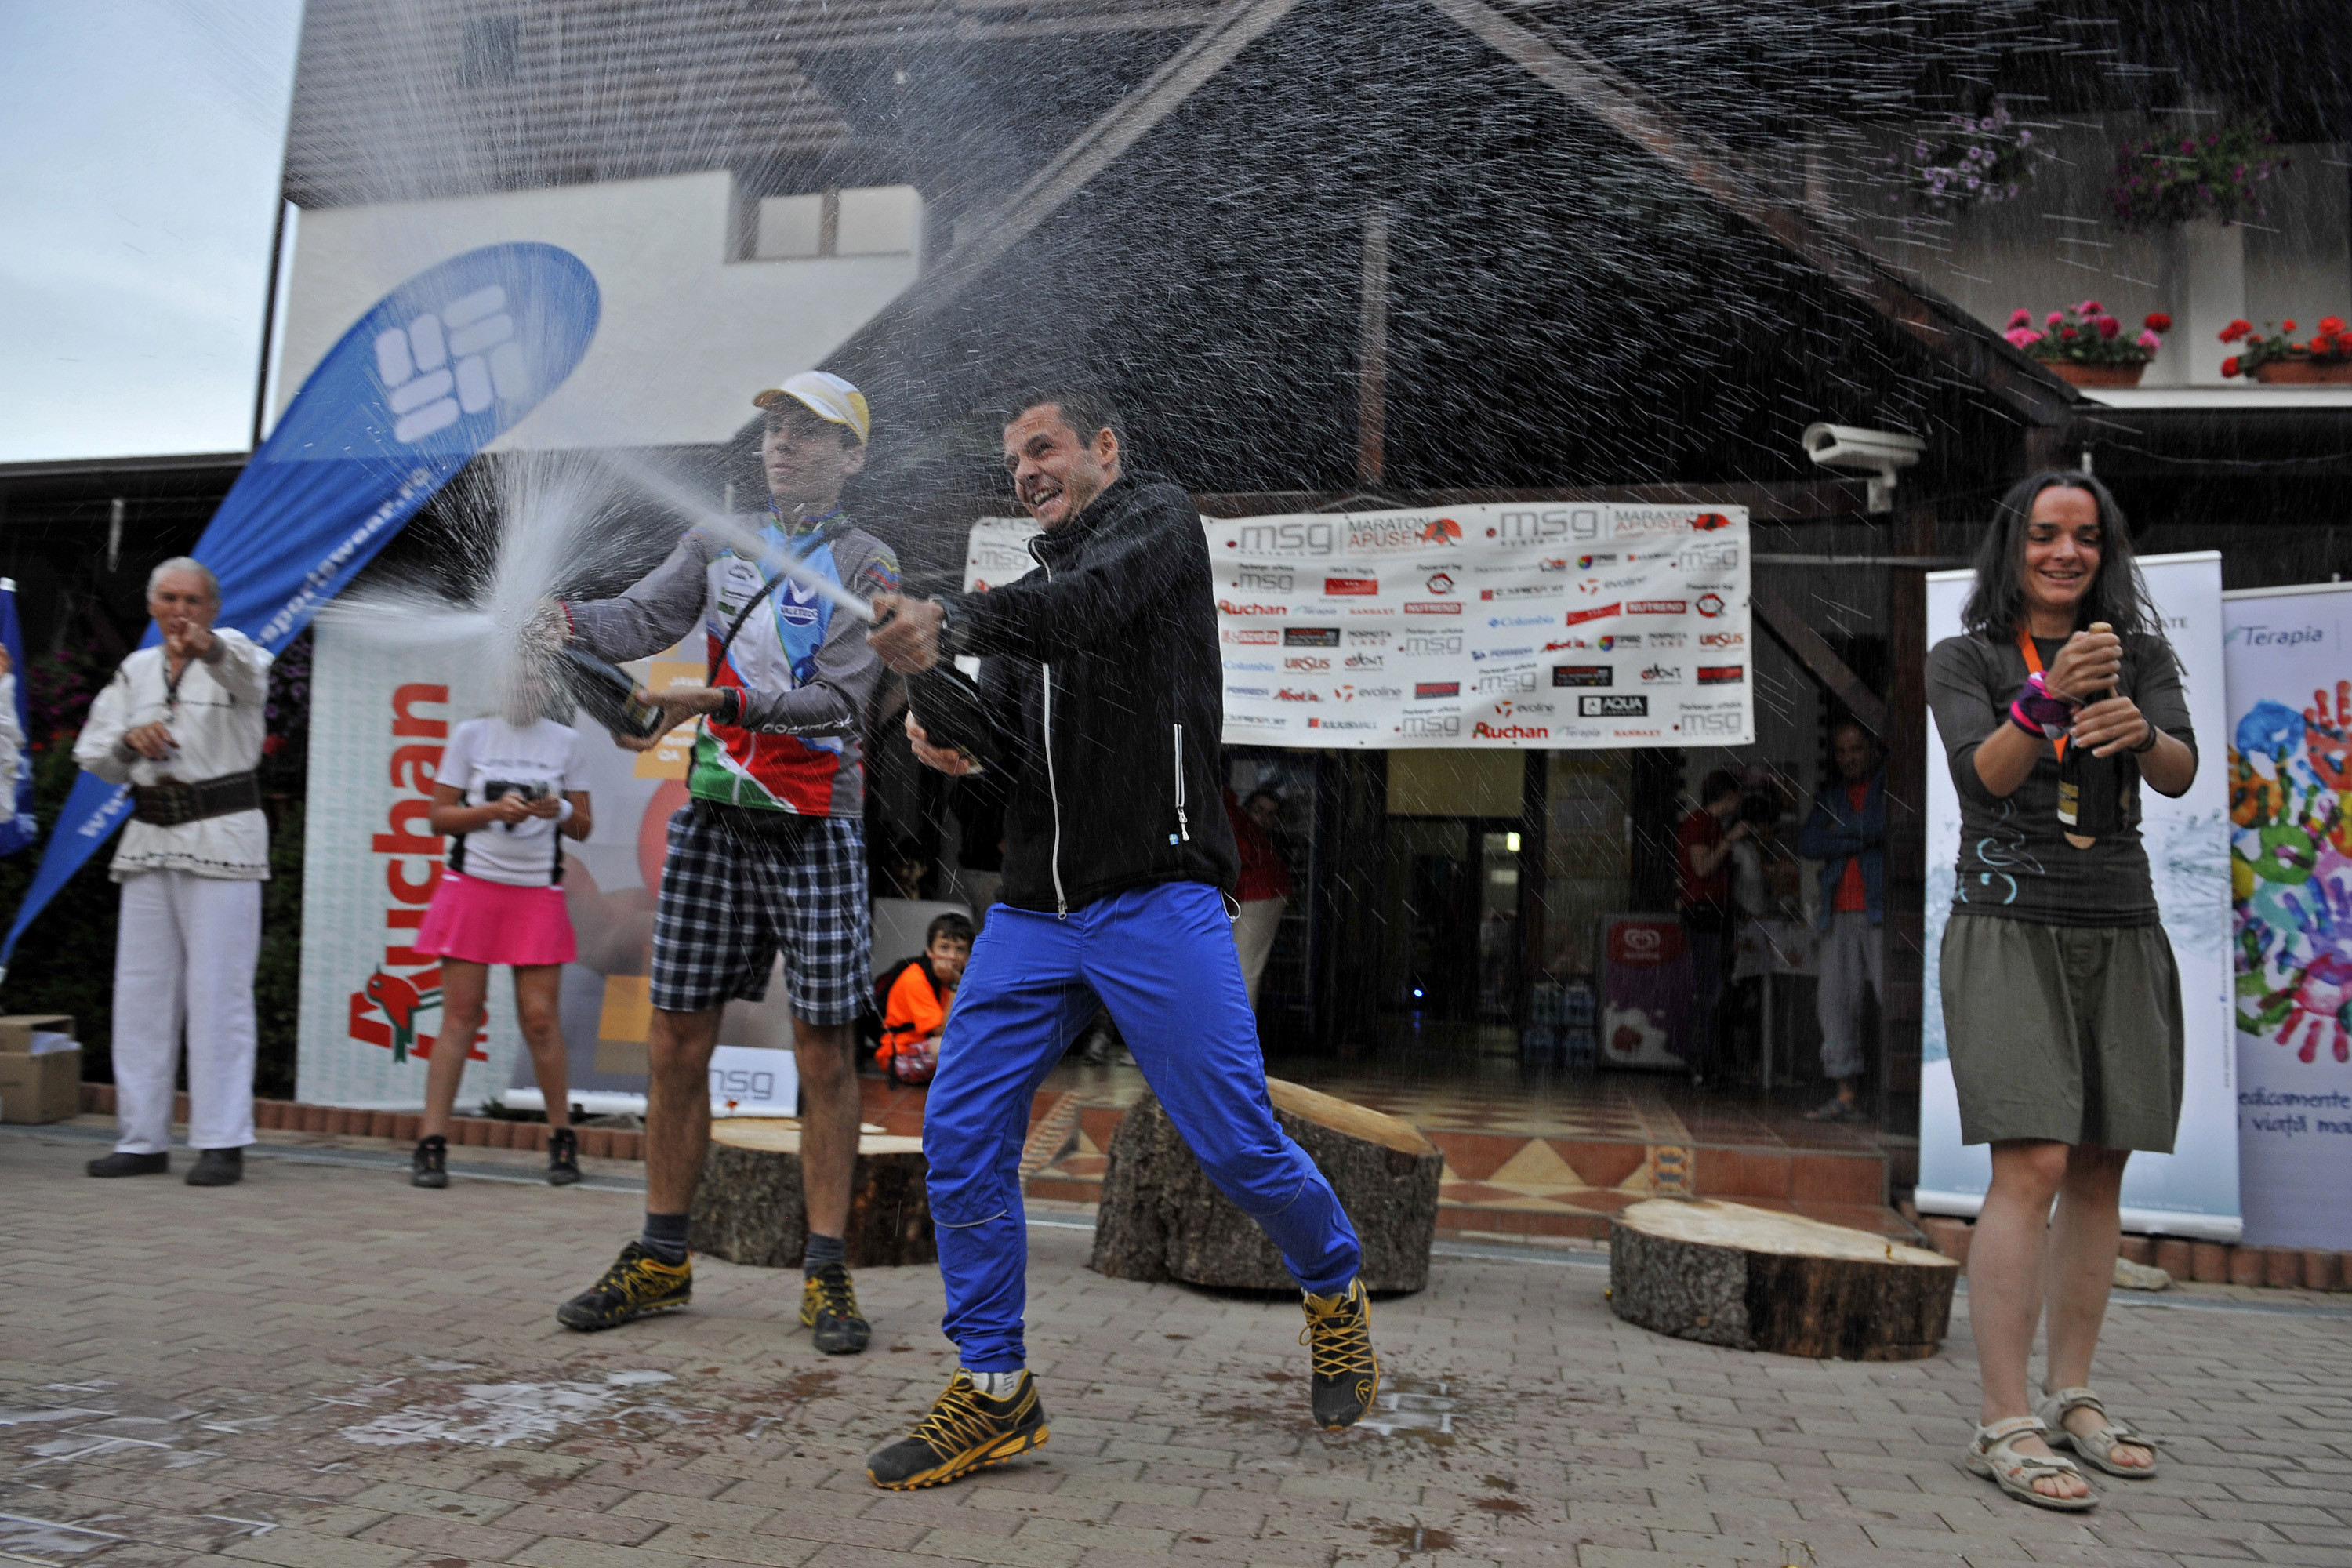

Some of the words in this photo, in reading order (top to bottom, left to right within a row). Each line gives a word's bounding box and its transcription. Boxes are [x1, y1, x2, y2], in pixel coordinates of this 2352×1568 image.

[1241, 524, 1332, 555] msg
[1348, 531, 1425, 547] APUSE
[1218, 599, 1287, 615] Auchan
[2240, 625, 2324, 648] Terapia
[1284, 656, 1330, 671] URSUS
[1473, 721, 1548, 739] Auchan
[2237, 1087, 2350, 1109] edicamente
